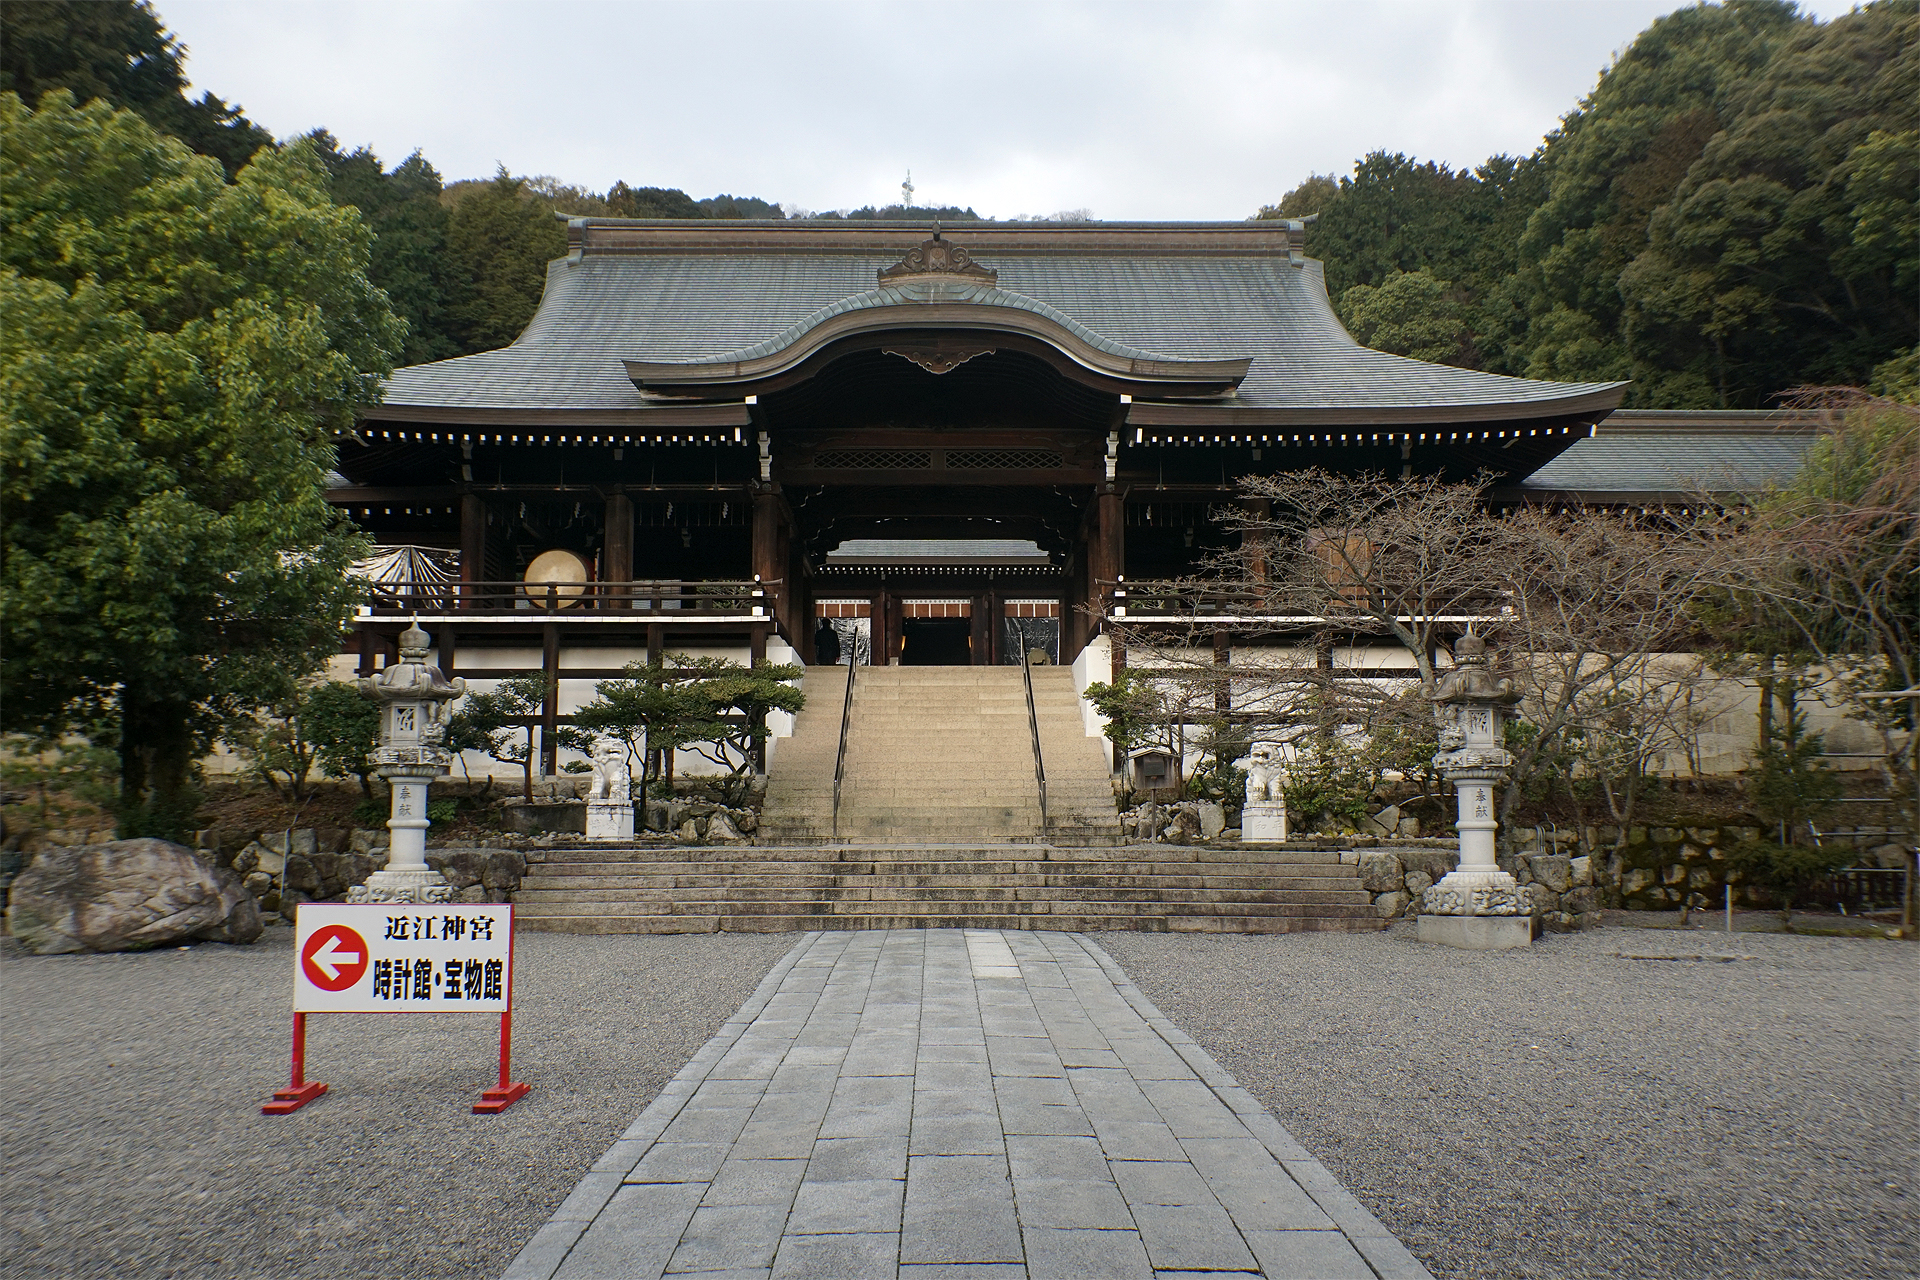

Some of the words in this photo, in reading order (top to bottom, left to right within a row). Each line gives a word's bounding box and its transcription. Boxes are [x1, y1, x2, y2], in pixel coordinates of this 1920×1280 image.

[399, 785, 412, 817] 奉献
[1474, 787, 1488, 818] 奉献
[384, 915, 495, 941] 近江神宮
[373, 958, 503, 1001] 時計館・宝物館
